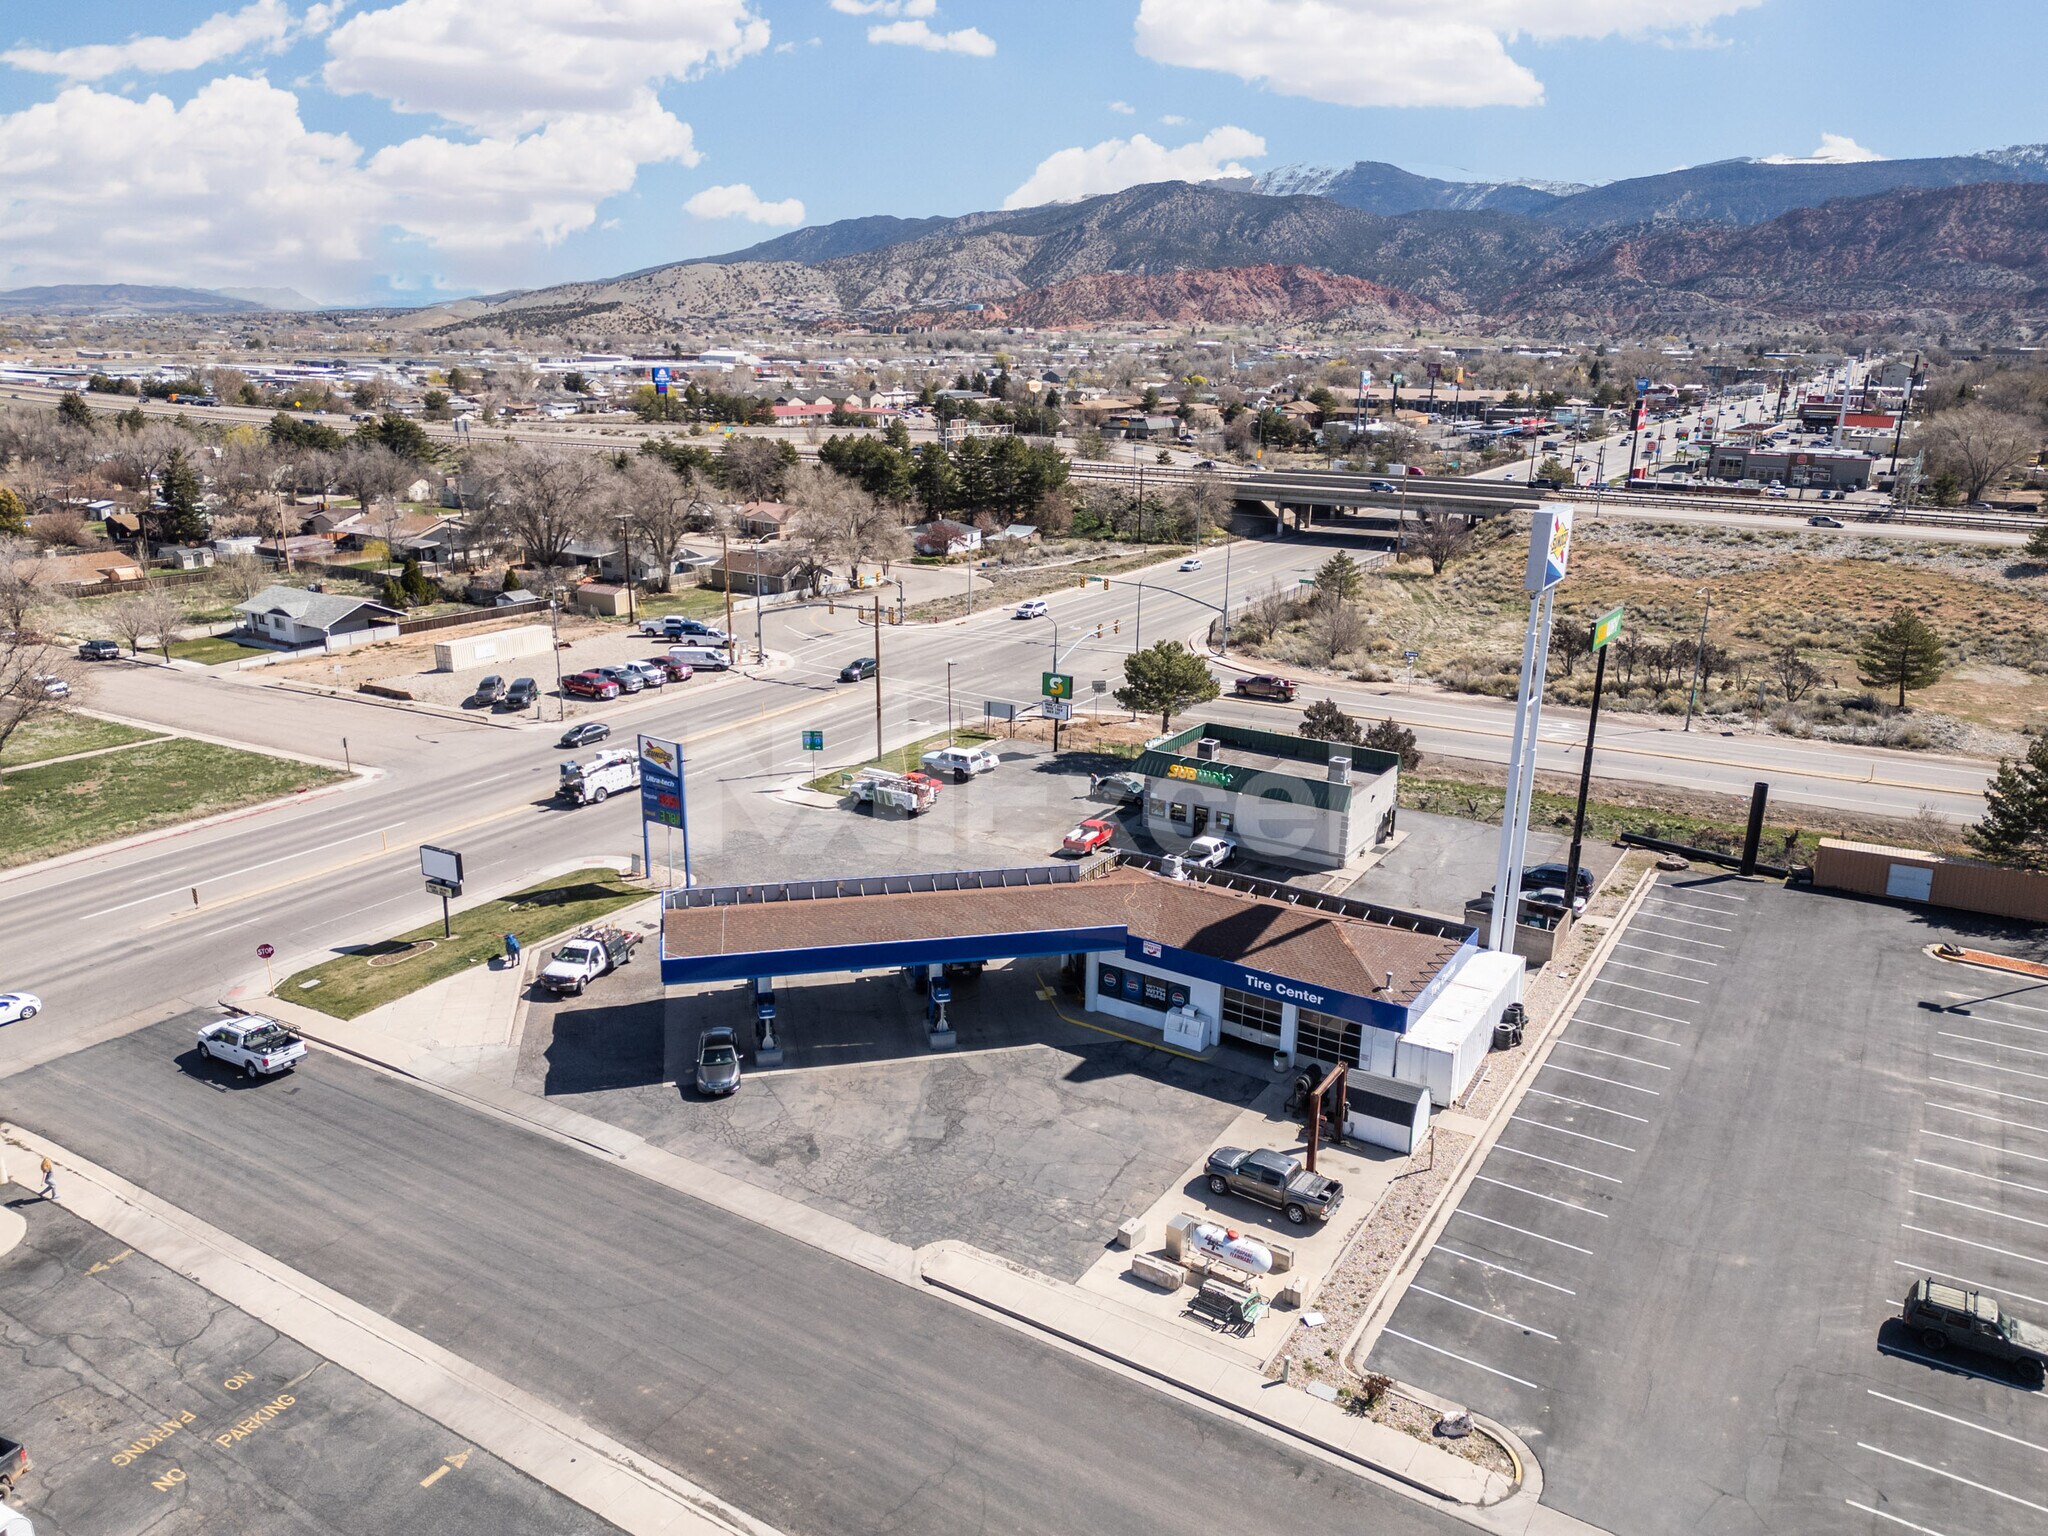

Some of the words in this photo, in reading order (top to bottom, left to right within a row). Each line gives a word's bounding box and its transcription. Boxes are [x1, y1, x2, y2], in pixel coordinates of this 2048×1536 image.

[257, 947, 273, 955] STOP
[1245, 974, 1272, 991] Tire
[1275, 983, 1324, 1005] Center
[223, 1370, 256, 1391] NO
[111, 1409, 197, 1467] PARKING
[151, 1468, 187, 1492] NO
[215, 1394, 296, 1448] PARKING
